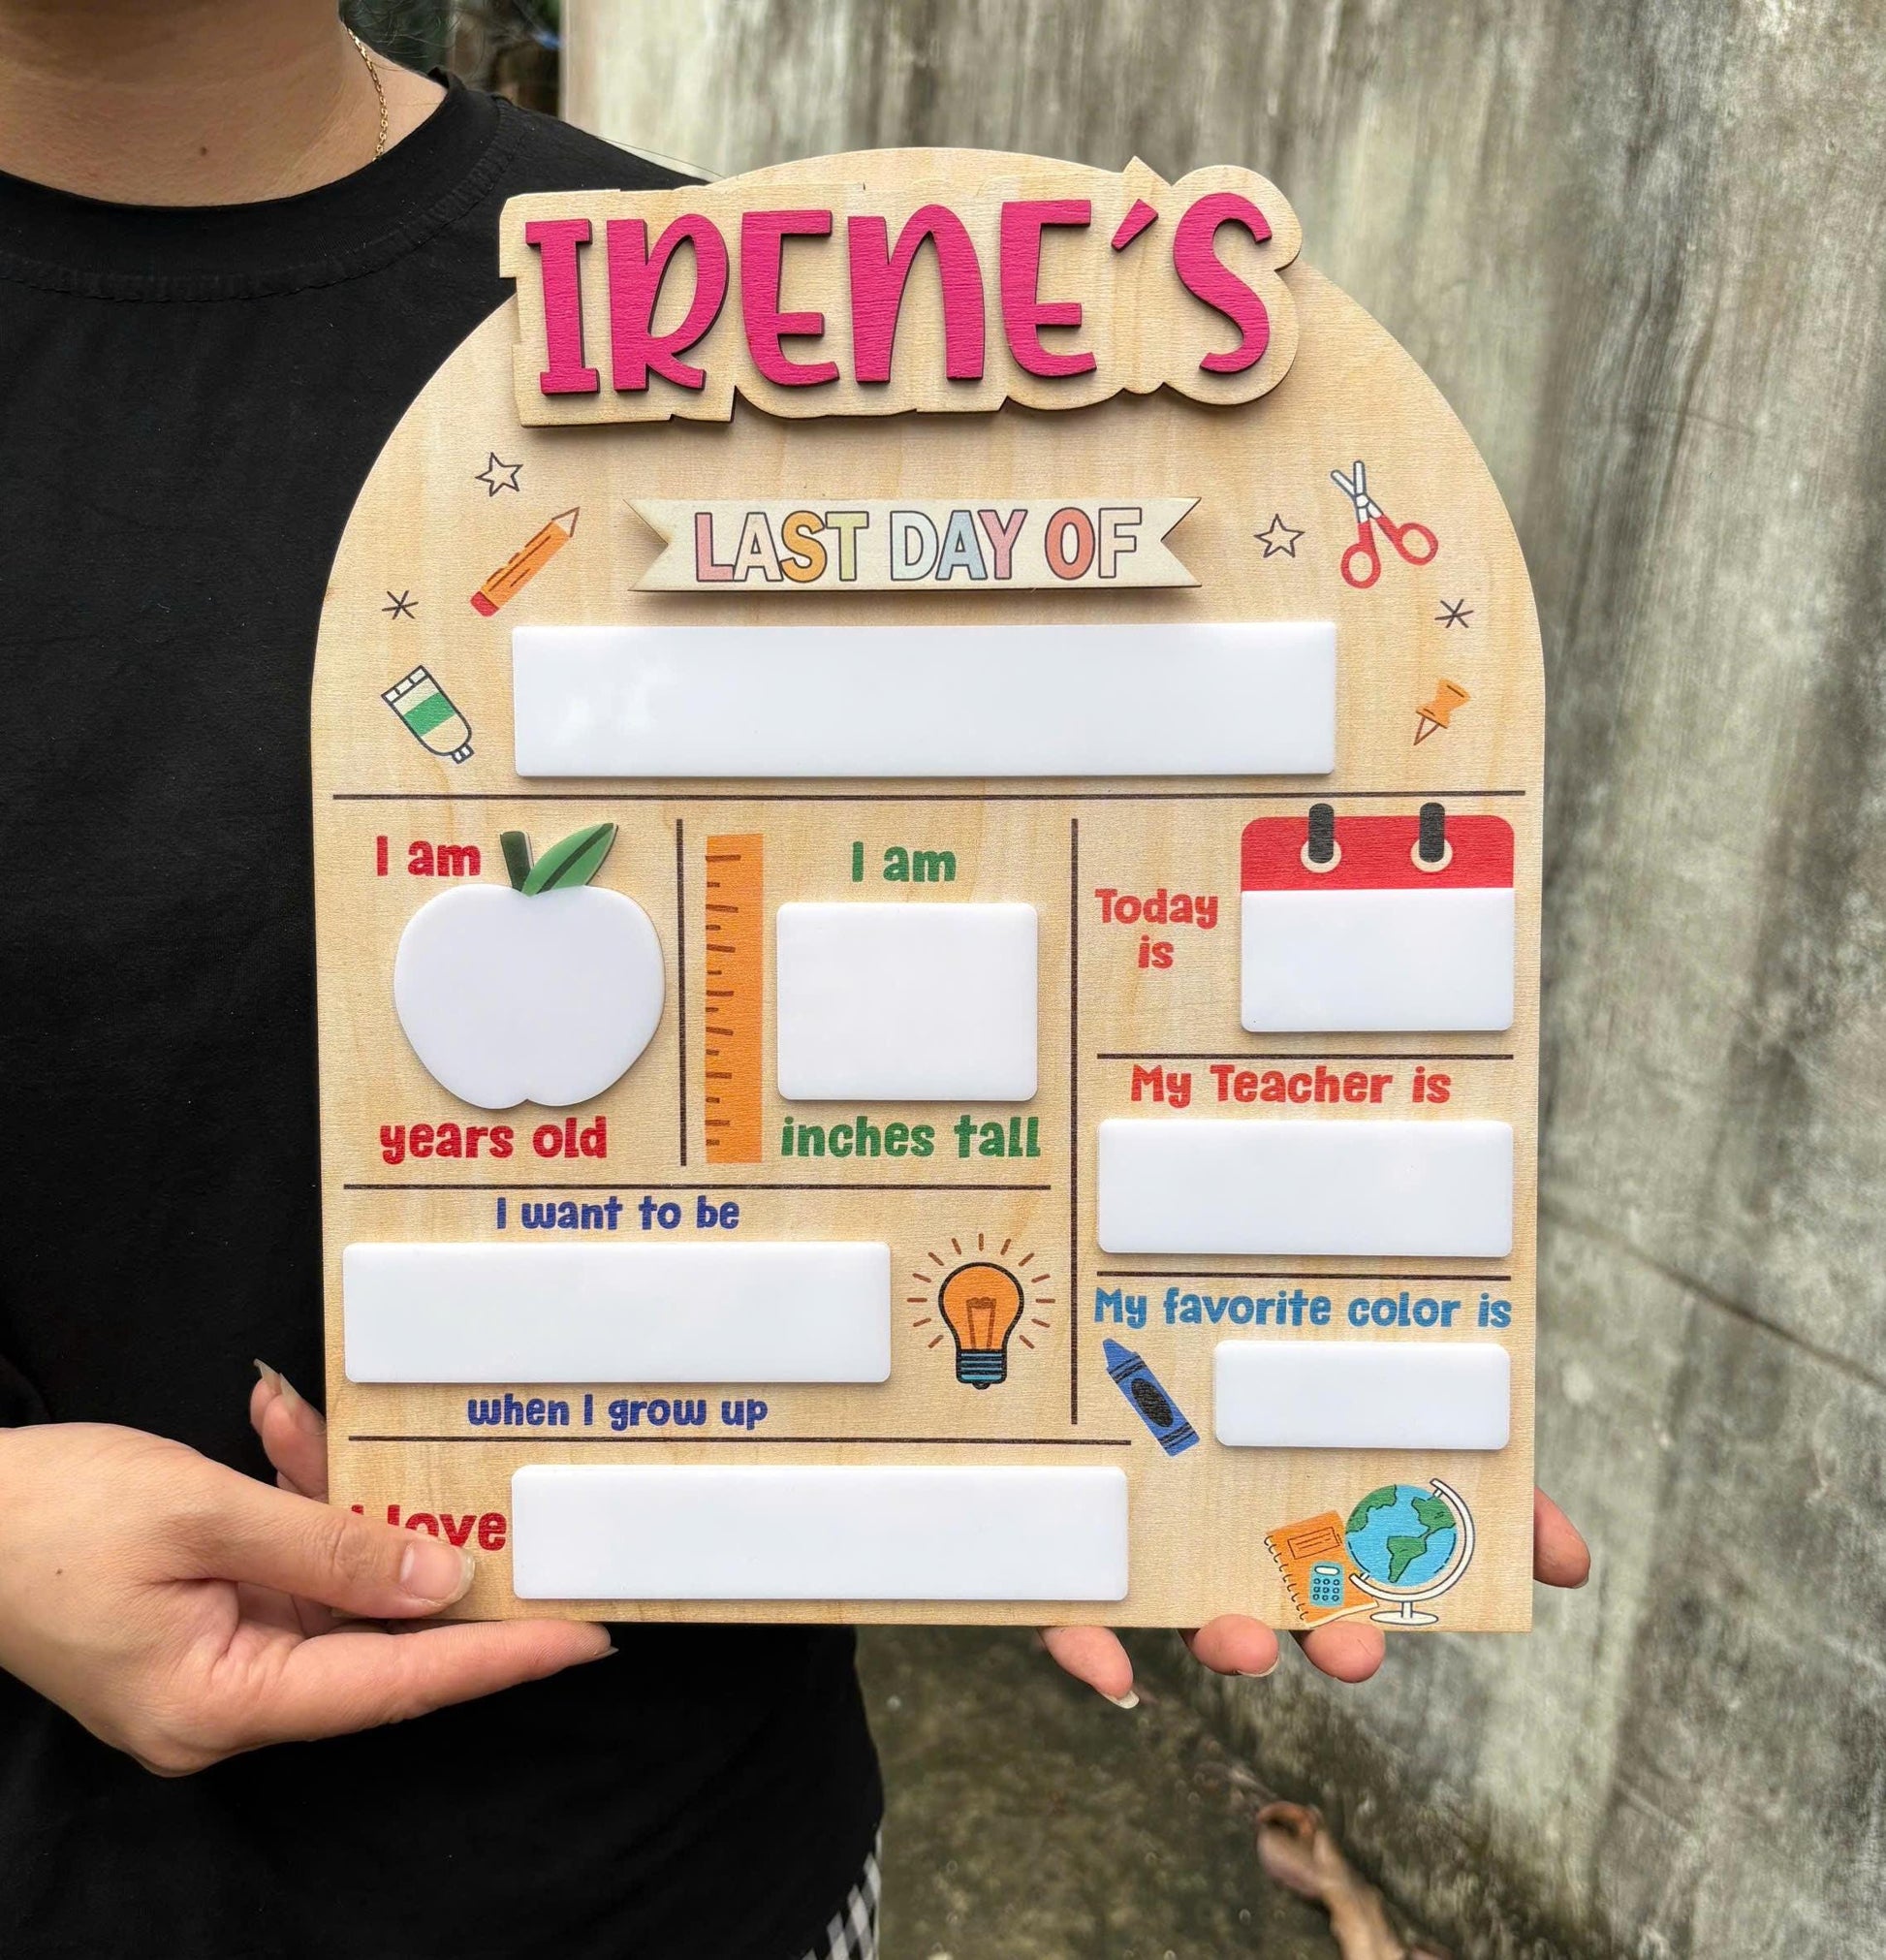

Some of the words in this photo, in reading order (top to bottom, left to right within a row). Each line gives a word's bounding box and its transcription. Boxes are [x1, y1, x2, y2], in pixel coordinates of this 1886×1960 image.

[694, 510, 869, 583] LAST
[890, 509, 1028, 581] DAY
[1045, 507, 1143, 580] OF
[376, 836, 389, 876] I
[407, 838, 482, 877] am
[852, 841, 864, 882] I
[883, 846, 957, 883] am
[1094, 888, 1219, 930] Today
[1137, 934, 1175, 969] is
[1130, 1064, 1192, 1109] My
[1210, 1064, 1393, 1104] Teacher
[1411, 1065, 1452, 1104] is
[379, 1122, 515, 1166] years
[532, 1115, 608, 1159] old
[781, 1117, 935, 1157] inches
[954, 1116, 1040, 1158] tall
[496, 1197, 507, 1230] I
[521, 1196, 623, 1230] want
[639, 1196, 682, 1230] to
[697, 1195, 739, 1230] be
[1094, 1287, 1147, 1329] My
[1163, 1286, 1333, 1327] favorite
[1348, 1292, 1461, 1328] color
[1478, 1292, 1512, 1328] is
[467, 1394, 570, 1426] when
[583, 1394, 594, 1425] I
[609, 1399, 707, 1432] grow
[721, 1400, 769, 1431] up
